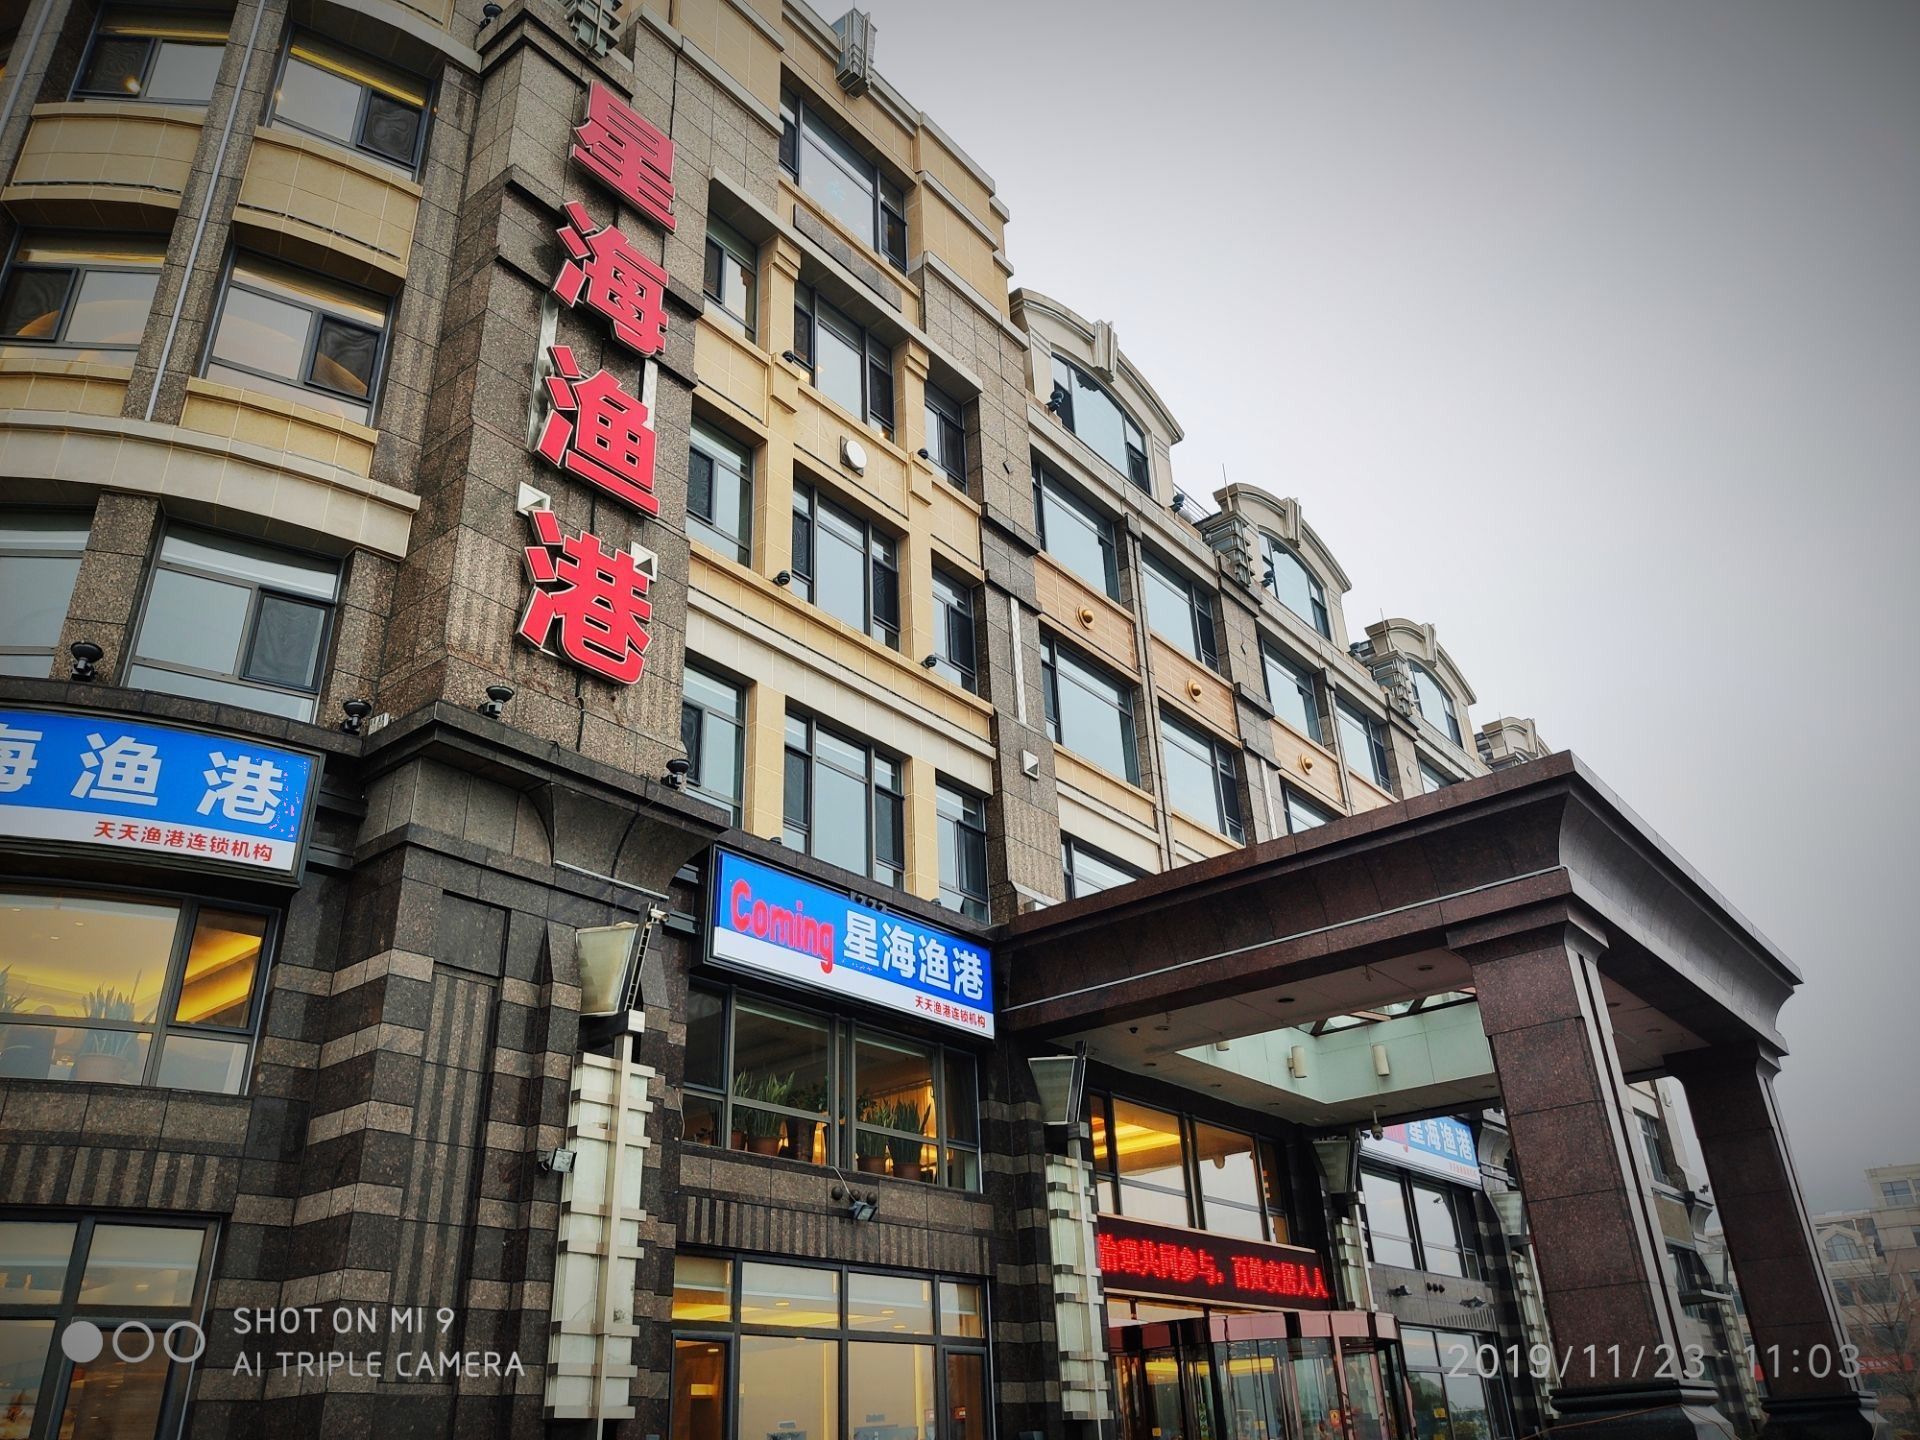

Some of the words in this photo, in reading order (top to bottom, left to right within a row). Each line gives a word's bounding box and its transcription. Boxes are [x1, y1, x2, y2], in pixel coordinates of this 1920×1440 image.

[517, 78, 677, 686] 星海渔港
[94, 821, 273, 862] 天天渔港连锁机构
[730, 878, 835, 975] Coming
[843, 910, 984, 1001] 星海渔港
[915, 995, 986, 1028] 天天渔港连锁机构
